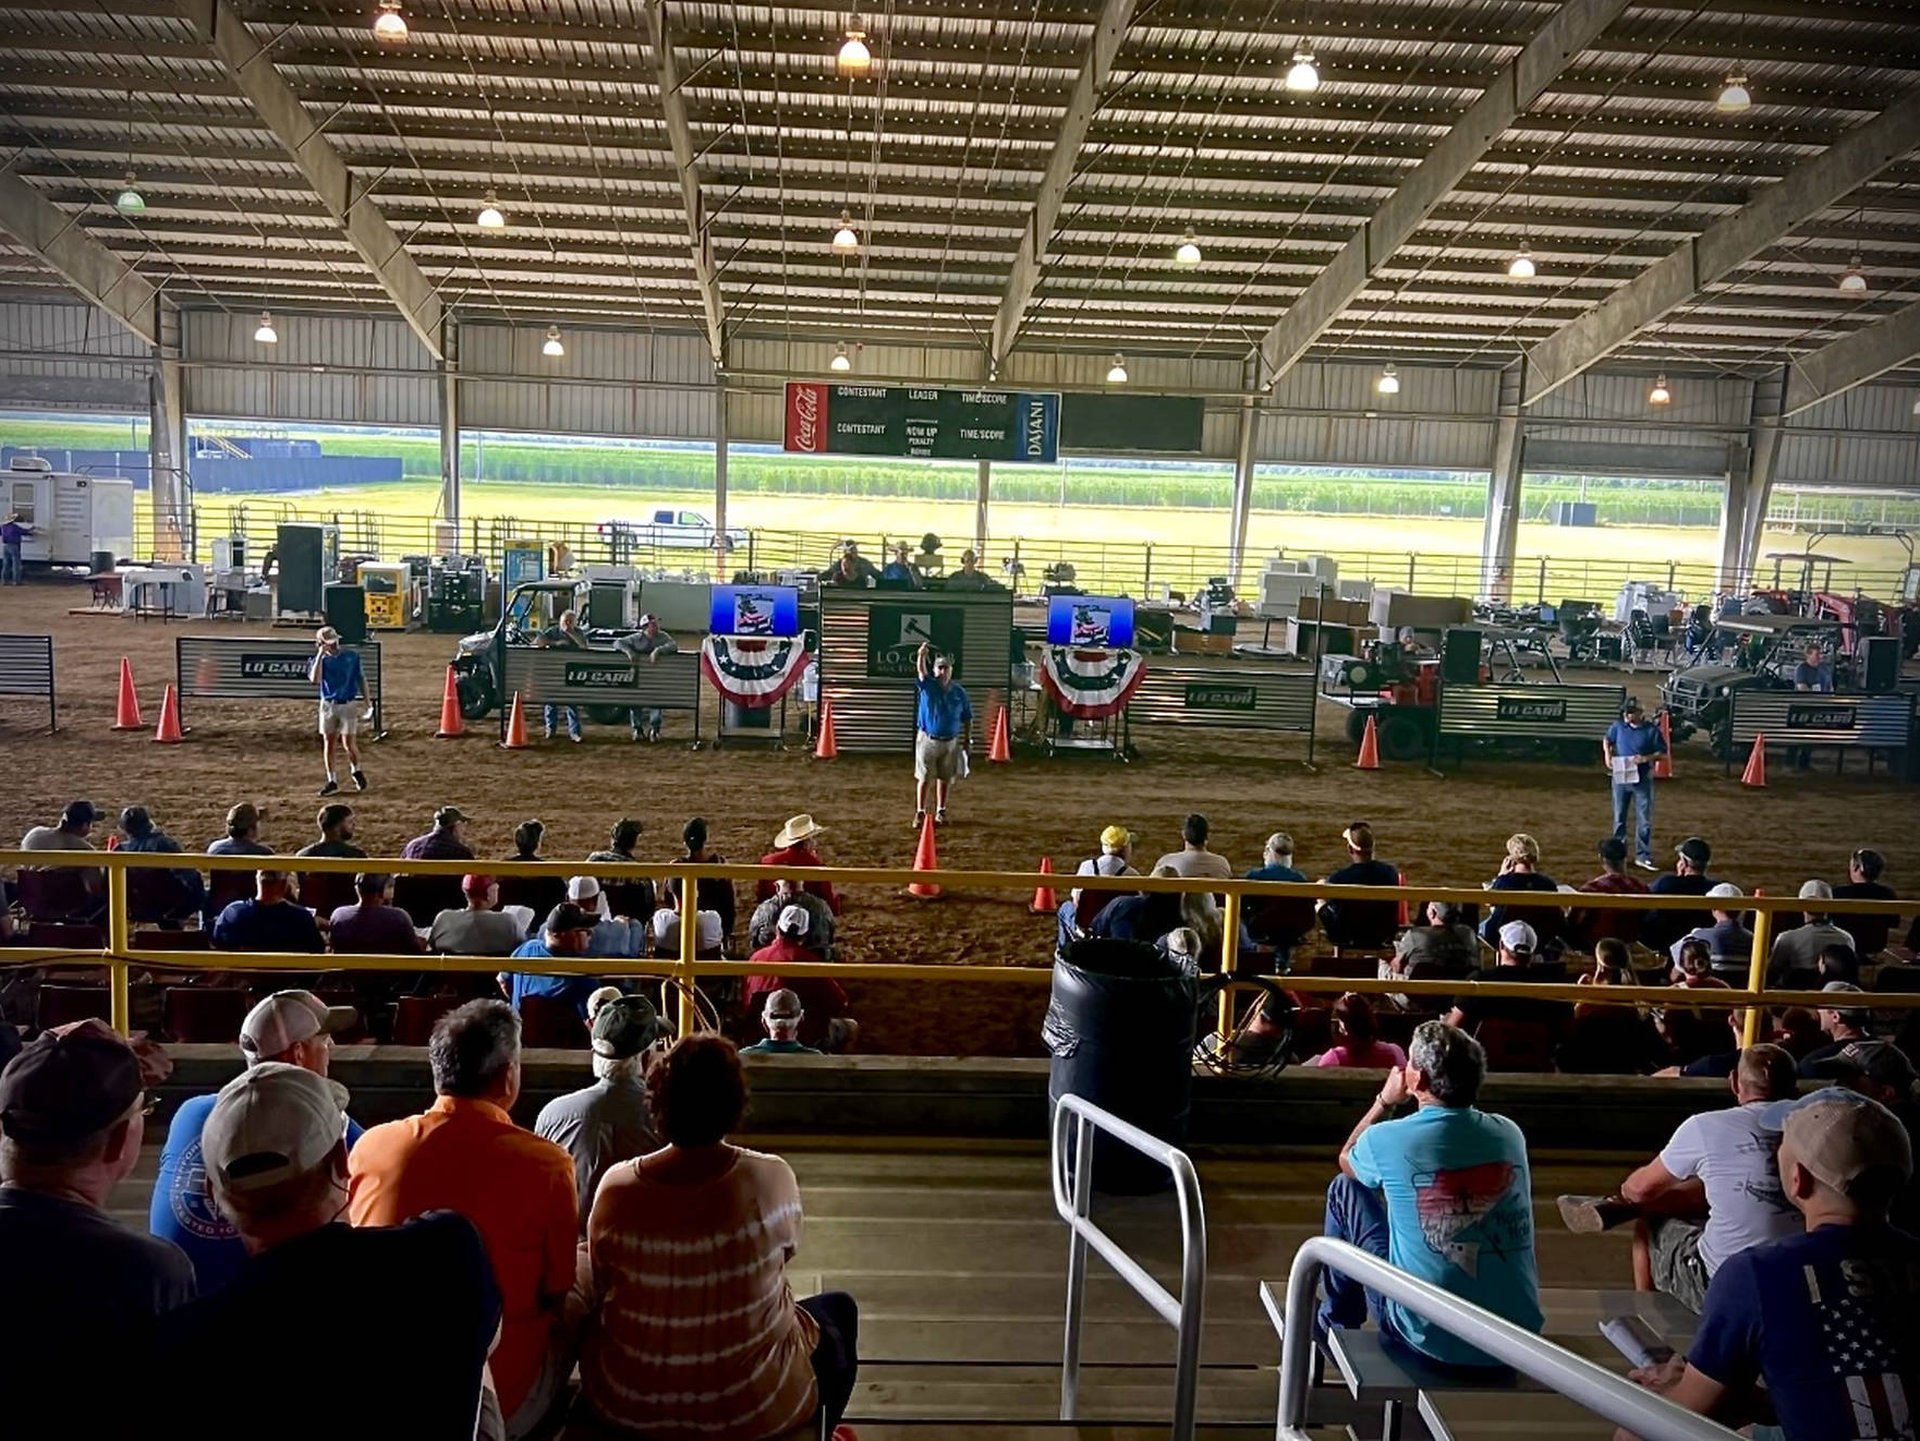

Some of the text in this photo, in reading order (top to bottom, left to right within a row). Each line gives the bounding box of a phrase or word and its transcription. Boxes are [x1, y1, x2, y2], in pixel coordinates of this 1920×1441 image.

[837, 386, 887, 398] CONTESTANT
[908, 389, 938, 401] LEADER
[795, 385, 818, 452] Coca-Cola
[836, 422, 886, 435] CONTESTANT
[906, 426, 938, 437] NOW UP
[1028, 401, 1044, 456] DASANI
[245, 662, 265, 673] LO
[569, 671, 588, 681] LO
